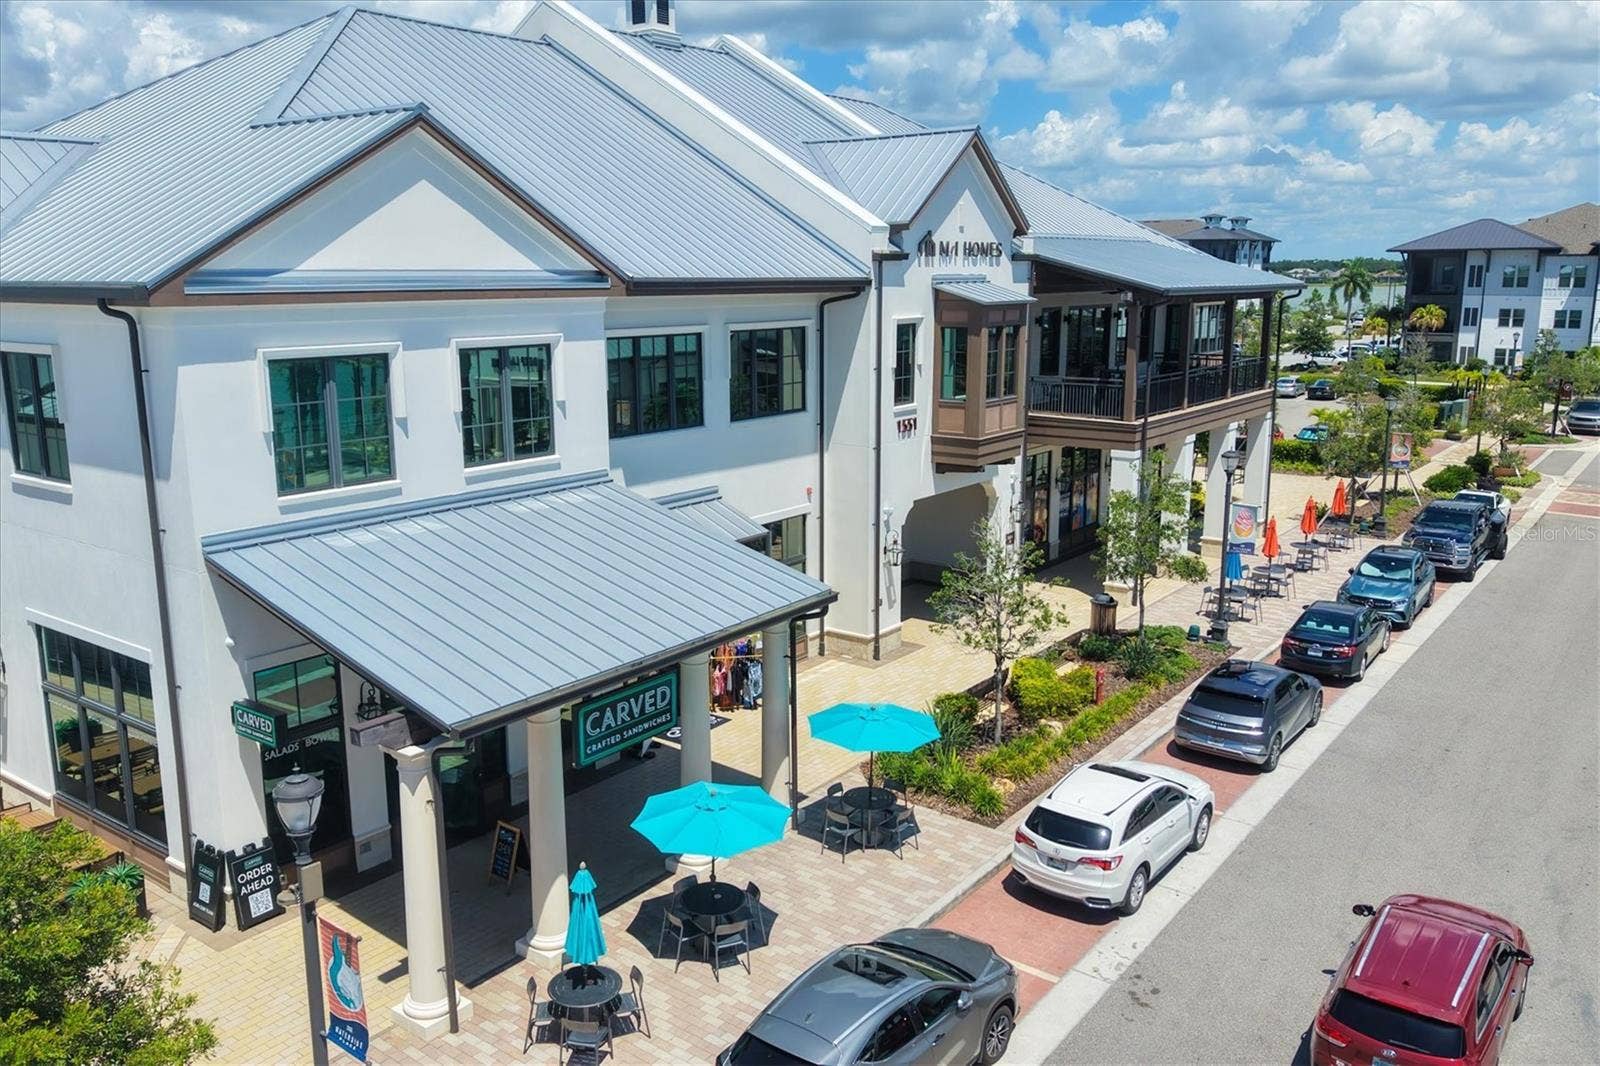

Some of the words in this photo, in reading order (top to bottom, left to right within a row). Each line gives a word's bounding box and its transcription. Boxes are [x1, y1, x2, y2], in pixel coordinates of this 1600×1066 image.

[963, 240, 1003, 258] HOMES
[896, 417, 917, 433] 1551
[236, 709, 272, 733] CARVED
[585, 685, 671, 736] CARVED
[586, 733, 621, 754] CRAFTED
[622, 712, 671, 739] SANDWICHES
[264, 742, 300, 761] SALADS
[237, 862, 273, 884] ORDER
[240, 874, 274, 896] AHEAD
